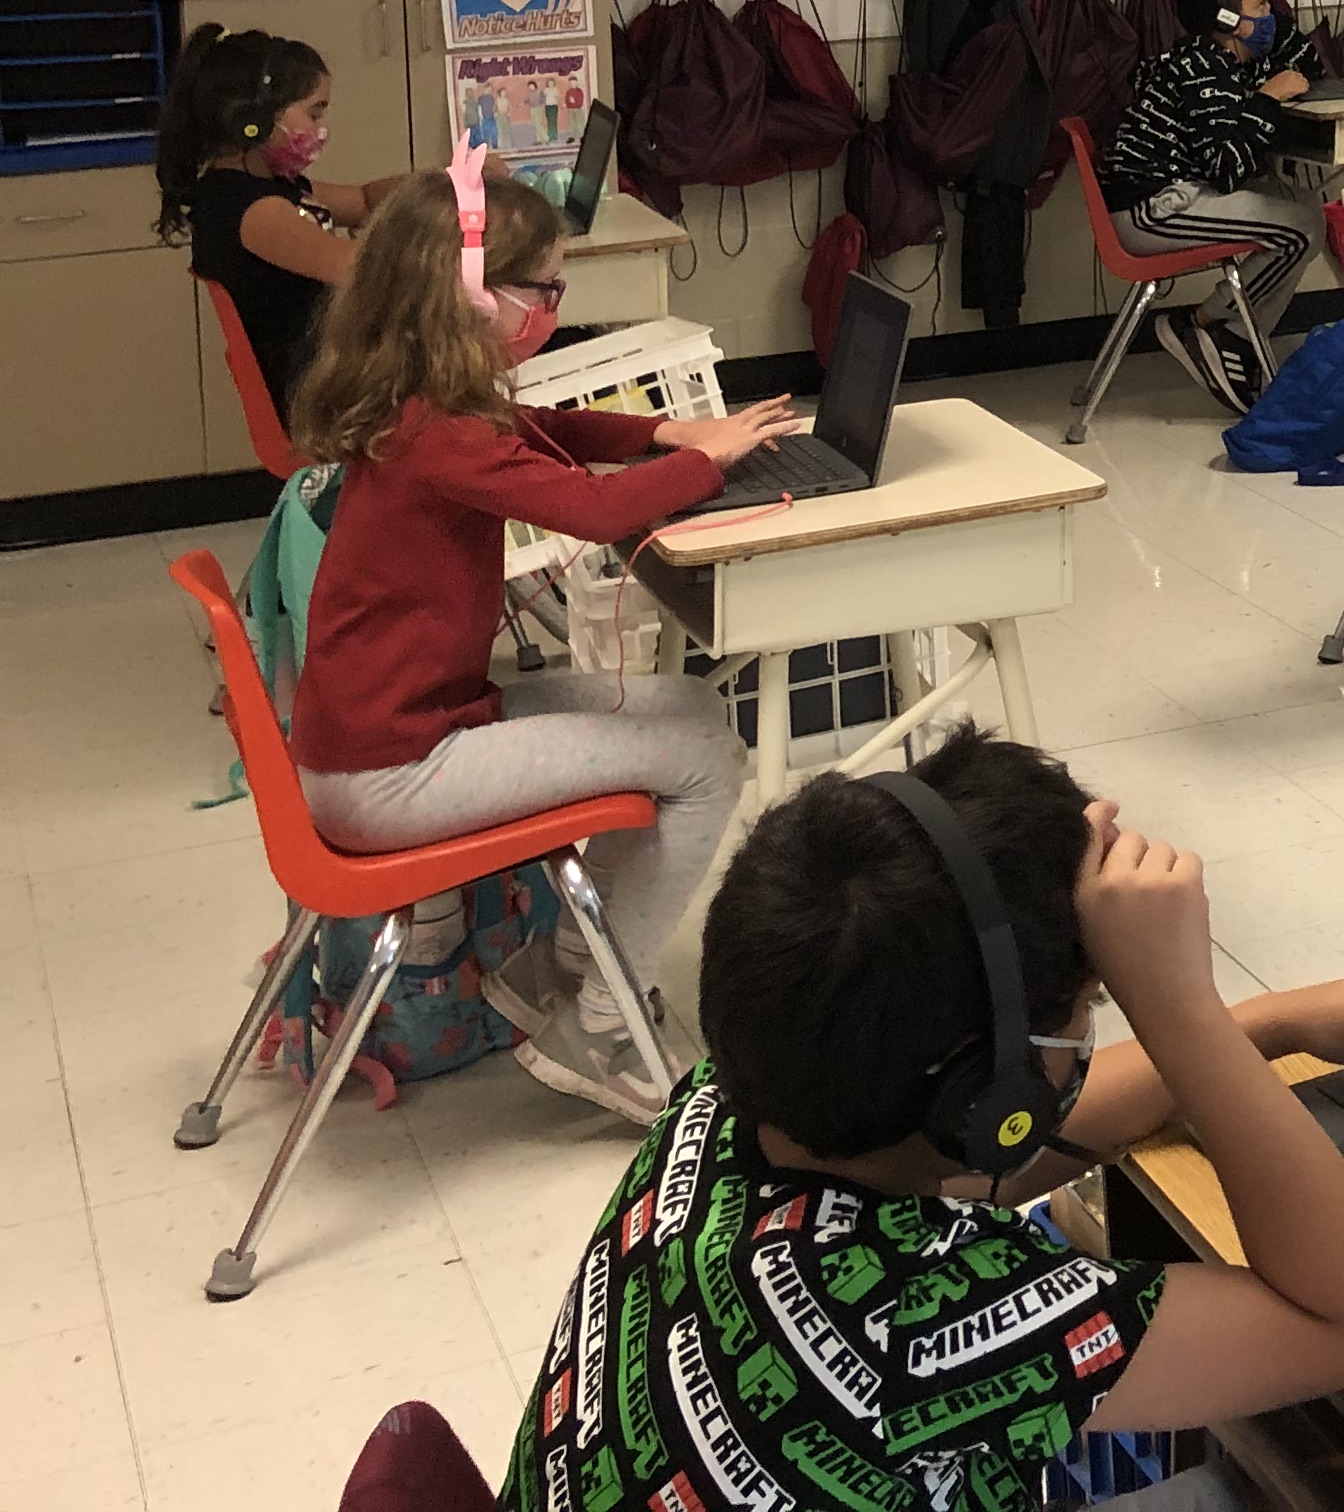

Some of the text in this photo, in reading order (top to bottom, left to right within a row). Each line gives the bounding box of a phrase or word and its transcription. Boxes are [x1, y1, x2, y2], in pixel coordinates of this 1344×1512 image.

[457, 54, 585, 83] Right Wrongs
[459, 8, 583, 38] Notice Hurts
[654, 1084, 719, 1248] INECRAFT
[576, 1238, 612, 1450] MINECRAFT
[693, 1174, 758, 1357] MINECRAFT
[1076, 1329, 1120, 1360] TNT
[616, 1264, 670, 1481] MINECRAFT
